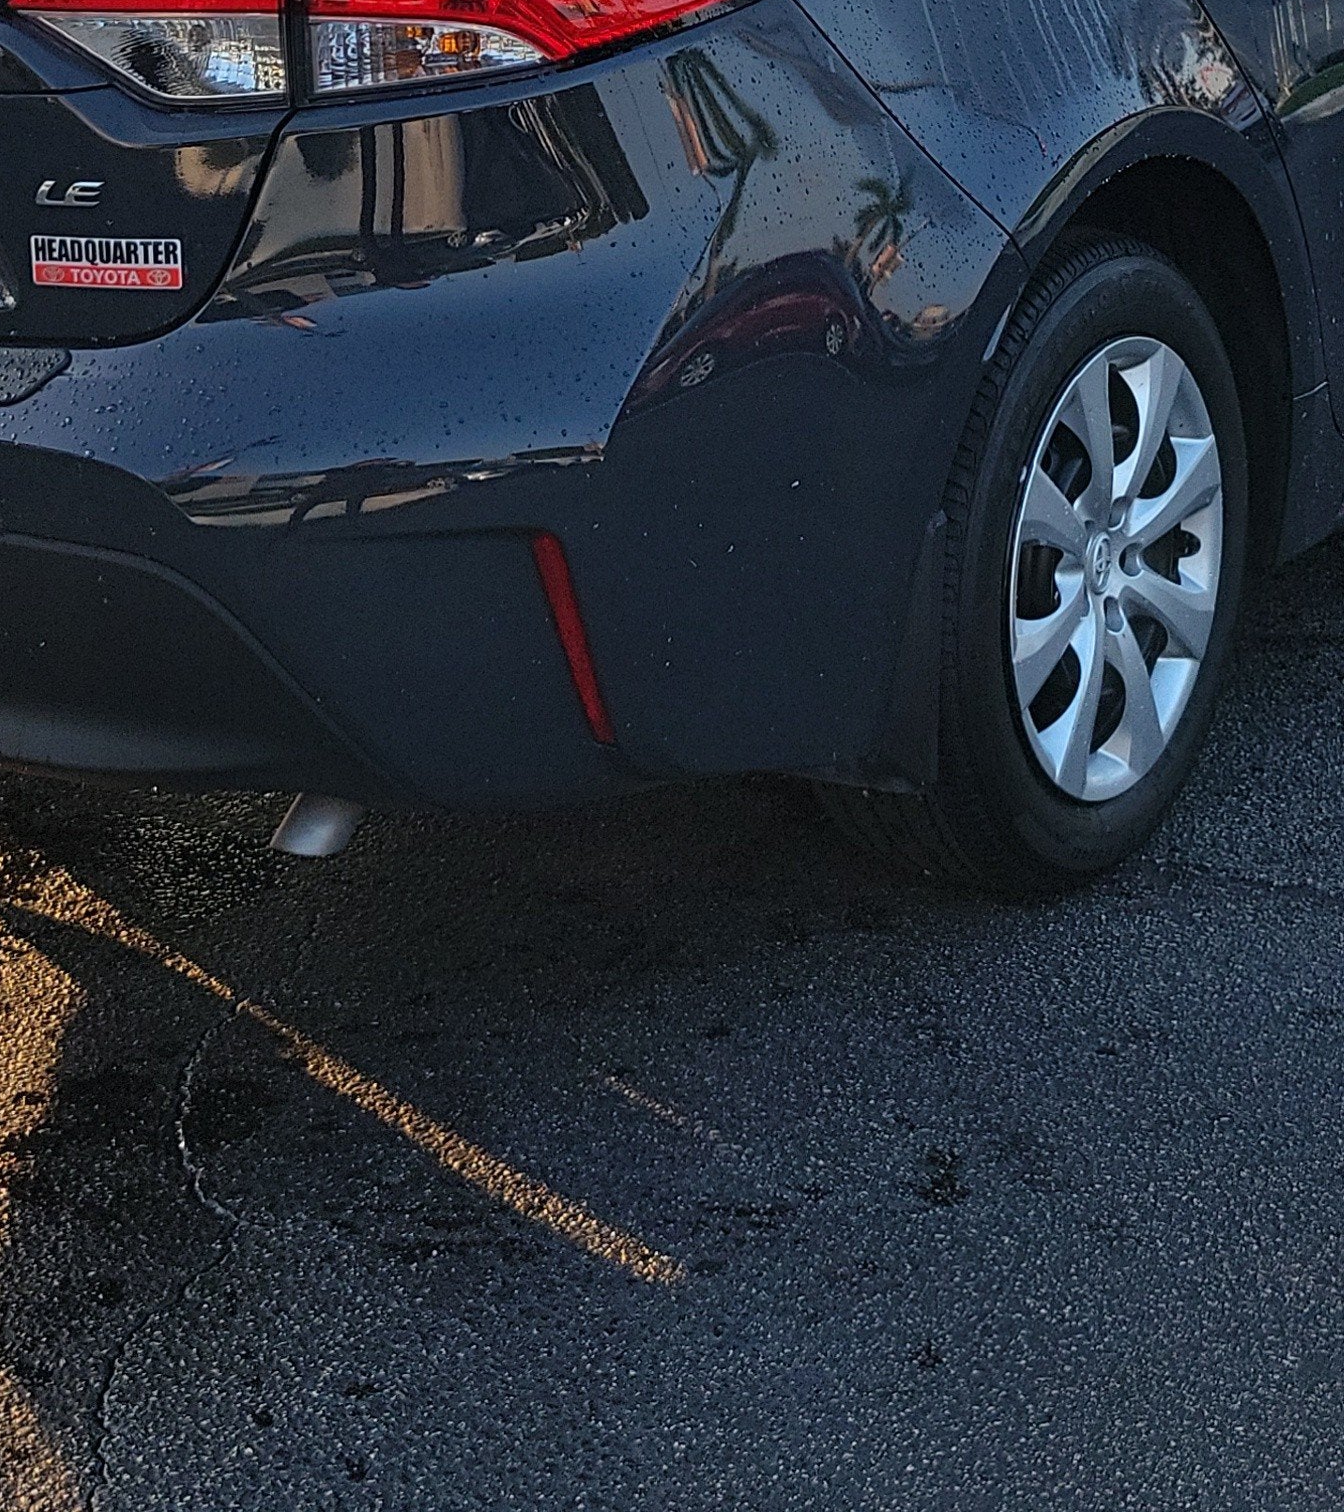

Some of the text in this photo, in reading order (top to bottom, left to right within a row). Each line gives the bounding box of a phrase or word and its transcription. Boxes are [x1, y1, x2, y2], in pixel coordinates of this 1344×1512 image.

[35, 180, 105, 207] LE
[34, 238, 178, 266] HEADQUARTER
[70, 268, 141, 285] TOYOTA
